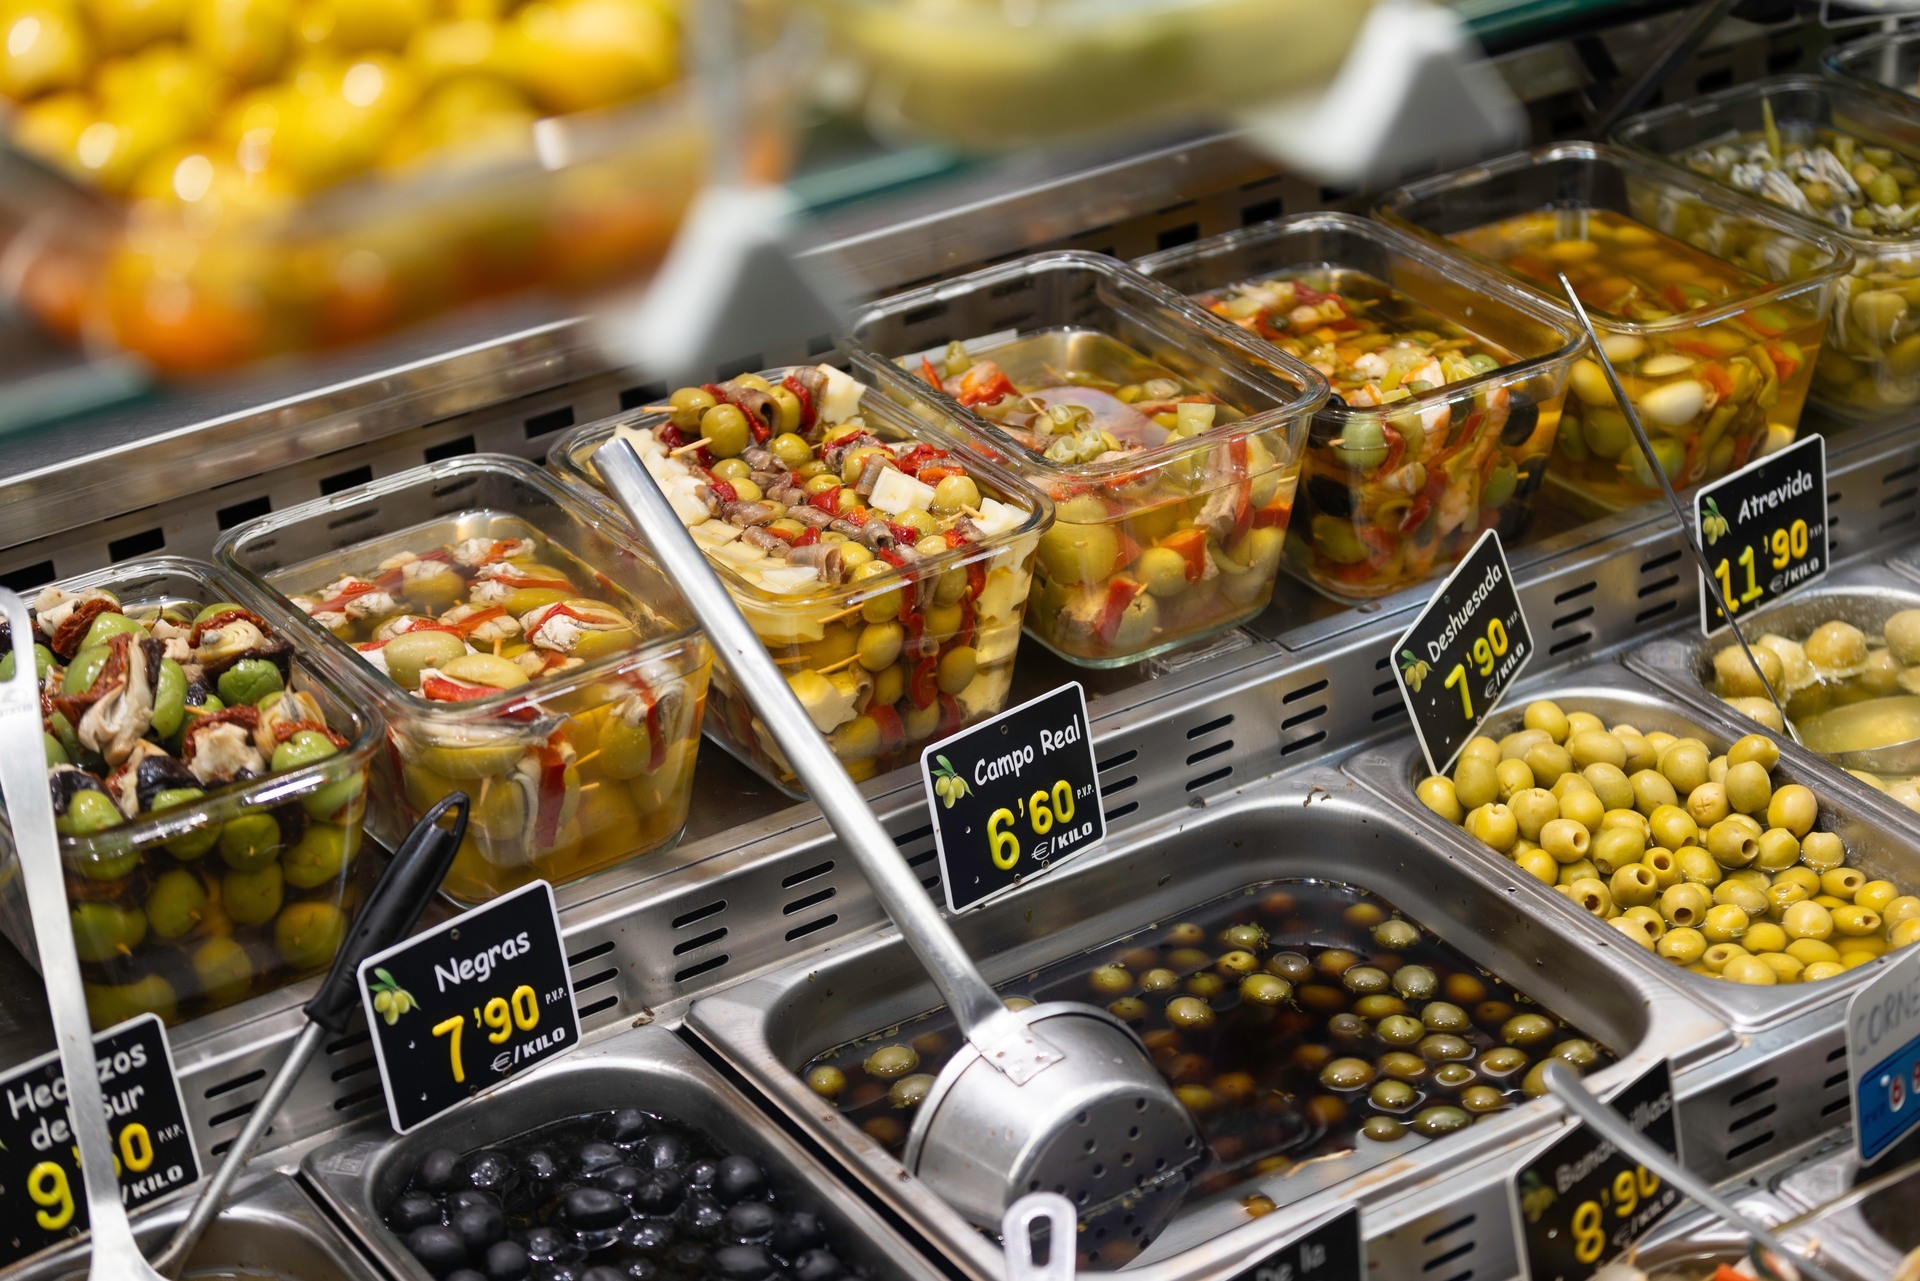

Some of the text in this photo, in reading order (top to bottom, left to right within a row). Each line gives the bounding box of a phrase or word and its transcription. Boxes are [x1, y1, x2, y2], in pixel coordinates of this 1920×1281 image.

[1738, 469, 1813, 525] Atrevida
[1714, 518, 1808, 618] 11'90
[1769, 557, 1820, 594] €/KILO
[1427, 563, 1503, 663] Deshuesada
[1444, 617, 1509, 720] 7'90
[1484, 642, 1525, 699] €/KILO
[974, 713, 1081, 786] Campo Real
[986, 779, 1094, 871] 6'60 P.V.P.
[1031, 821, 1093, 861] €/KILO
[434, 931, 531, 993] Negras
[432, 984, 567, 1083] 7'90 P.V.P.
[490, 1026, 566, 1072] €/KILO
[7, 1043, 147, 1120] Heczos
[27, 1122, 154, 1230] 9'0
[122, 1164, 184, 1204] /KILO
